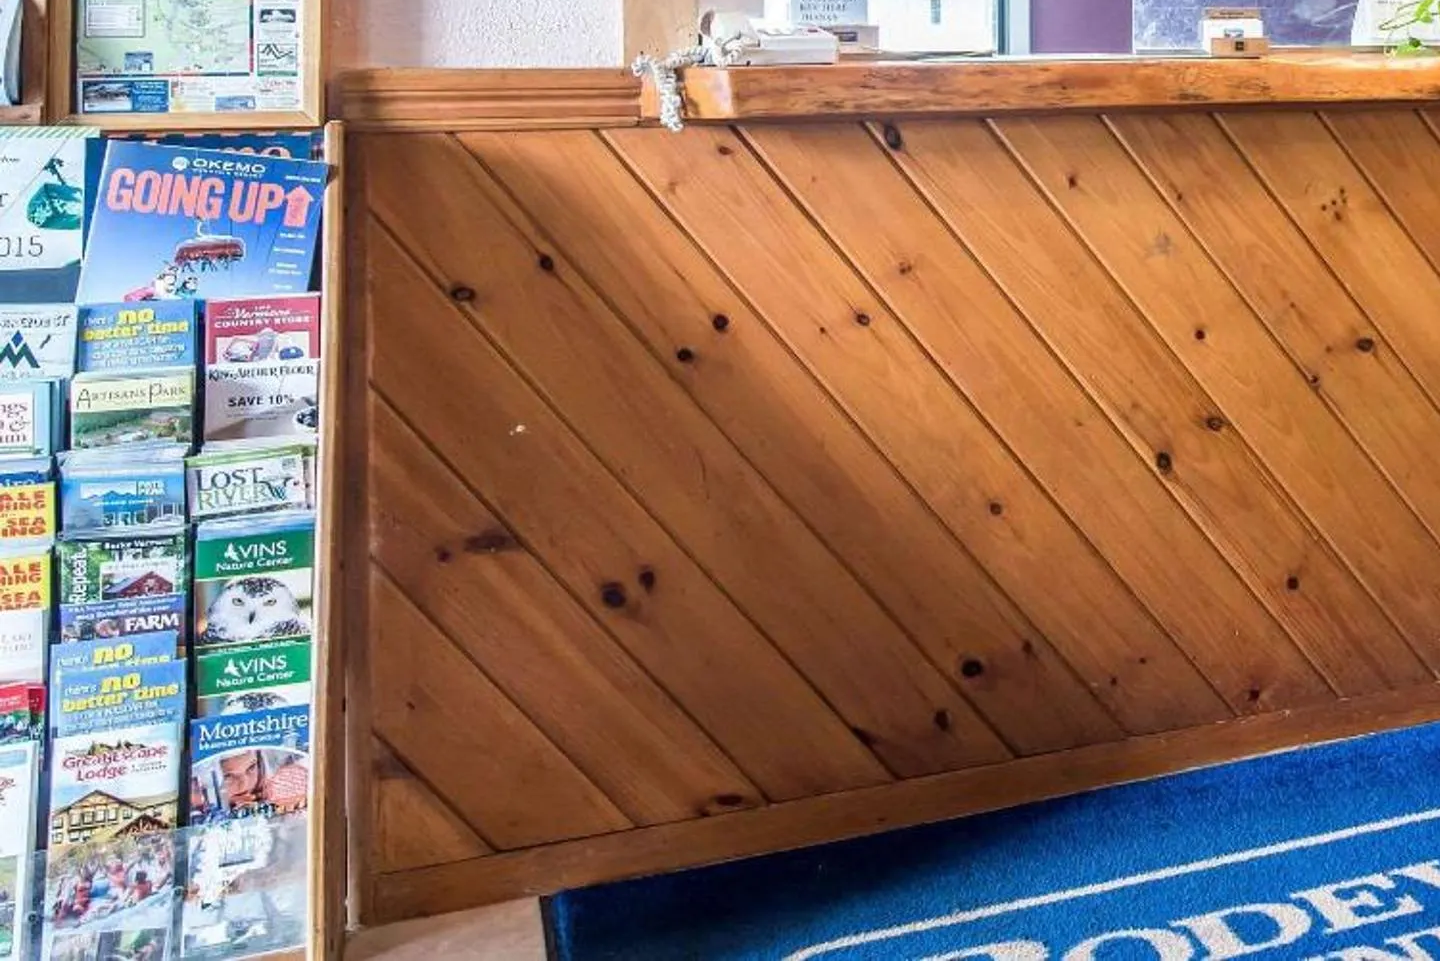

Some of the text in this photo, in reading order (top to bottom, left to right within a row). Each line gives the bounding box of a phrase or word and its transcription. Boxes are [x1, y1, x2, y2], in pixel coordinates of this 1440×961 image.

[193, 157, 266, 174] OKEMO
[106, 167, 285, 226] GOING UP
[227, 396, 264, 408] SAVE
[197, 467, 264, 492] LOST
[238, 540, 287, 559] VINS
[125, 613, 179, 632] FARM
[238, 655, 287, 674] VINS
[100, 672, 140, 694] no
[200, 713, 308, 742] Montshire
[76, 766, 128, 782] Lodge
